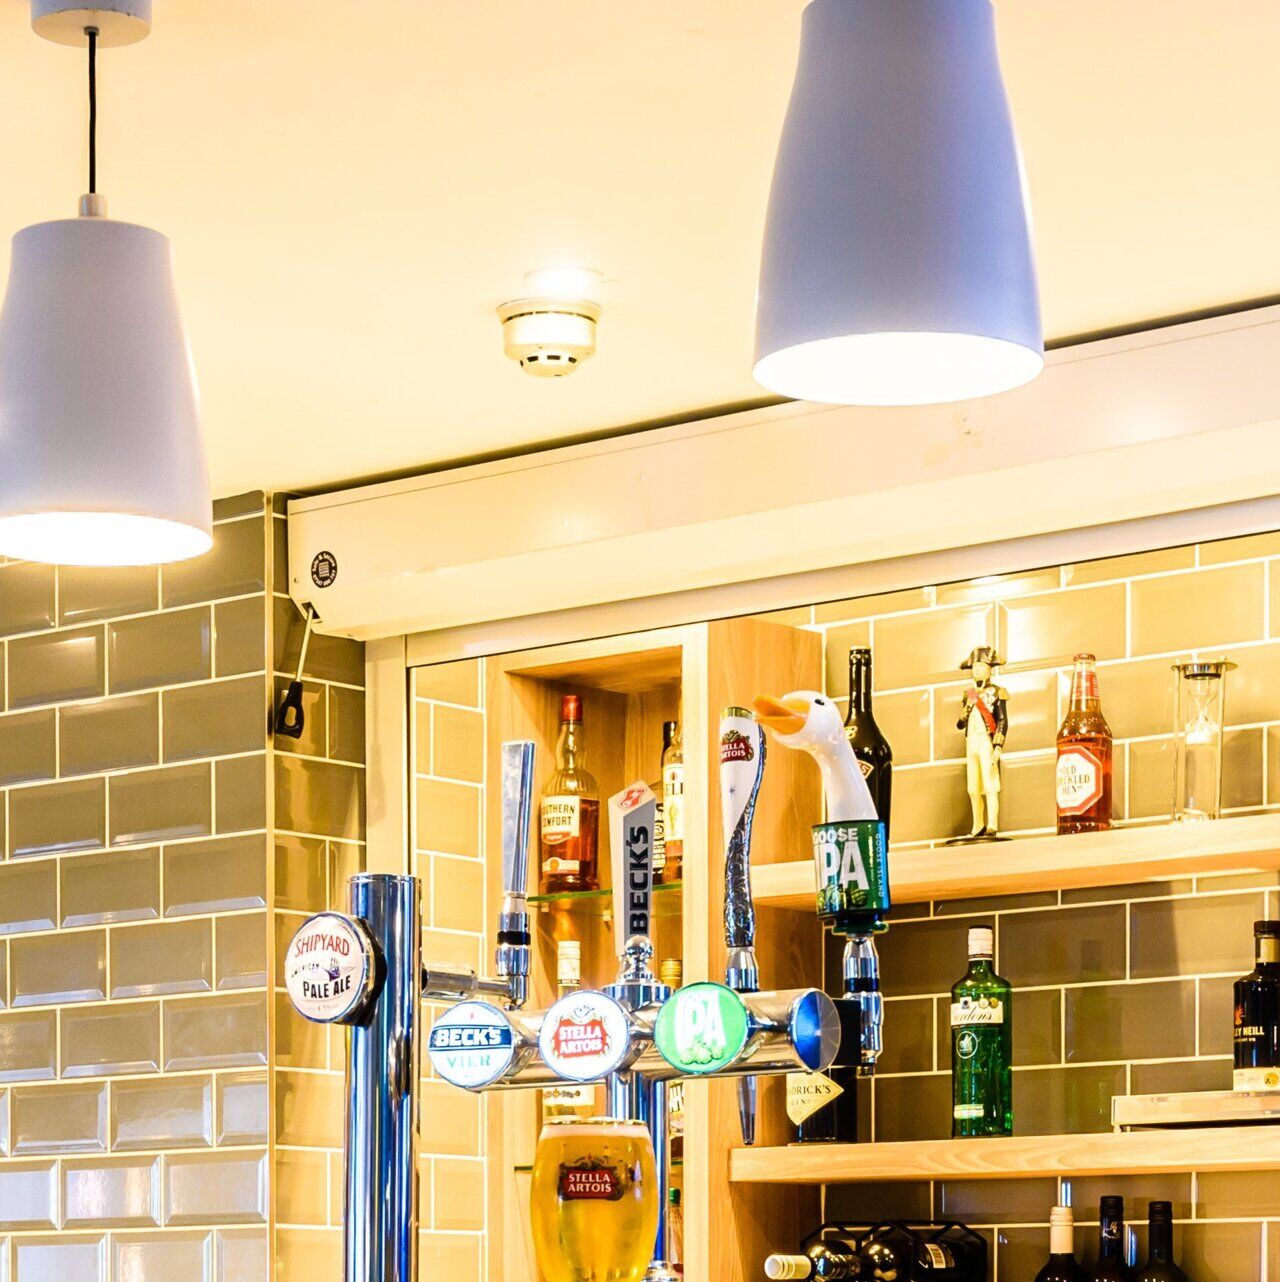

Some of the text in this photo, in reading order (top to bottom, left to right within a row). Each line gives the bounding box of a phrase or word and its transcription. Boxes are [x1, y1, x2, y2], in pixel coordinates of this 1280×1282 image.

[813, 828, 858, 844] GOOSE
[630, 824, 649, 935] BECK'S
[295, 934, 350, 958] SHIPYARD
[303, 975, 351, 998] PALE ALE
[434, 1027, 501, 1046] BECK'S
[559, 1026, 602, 1040] STELLA
[1243, 1026, 1264, 1035] NEILL
[560, 1039, 602, 1054] ARTOIS
[789, 1085, 831, 1095] DRICK'S
[569, 1174, 610, 1182] STELLA
[568, 1184, 611, 1192] ARTOIS
